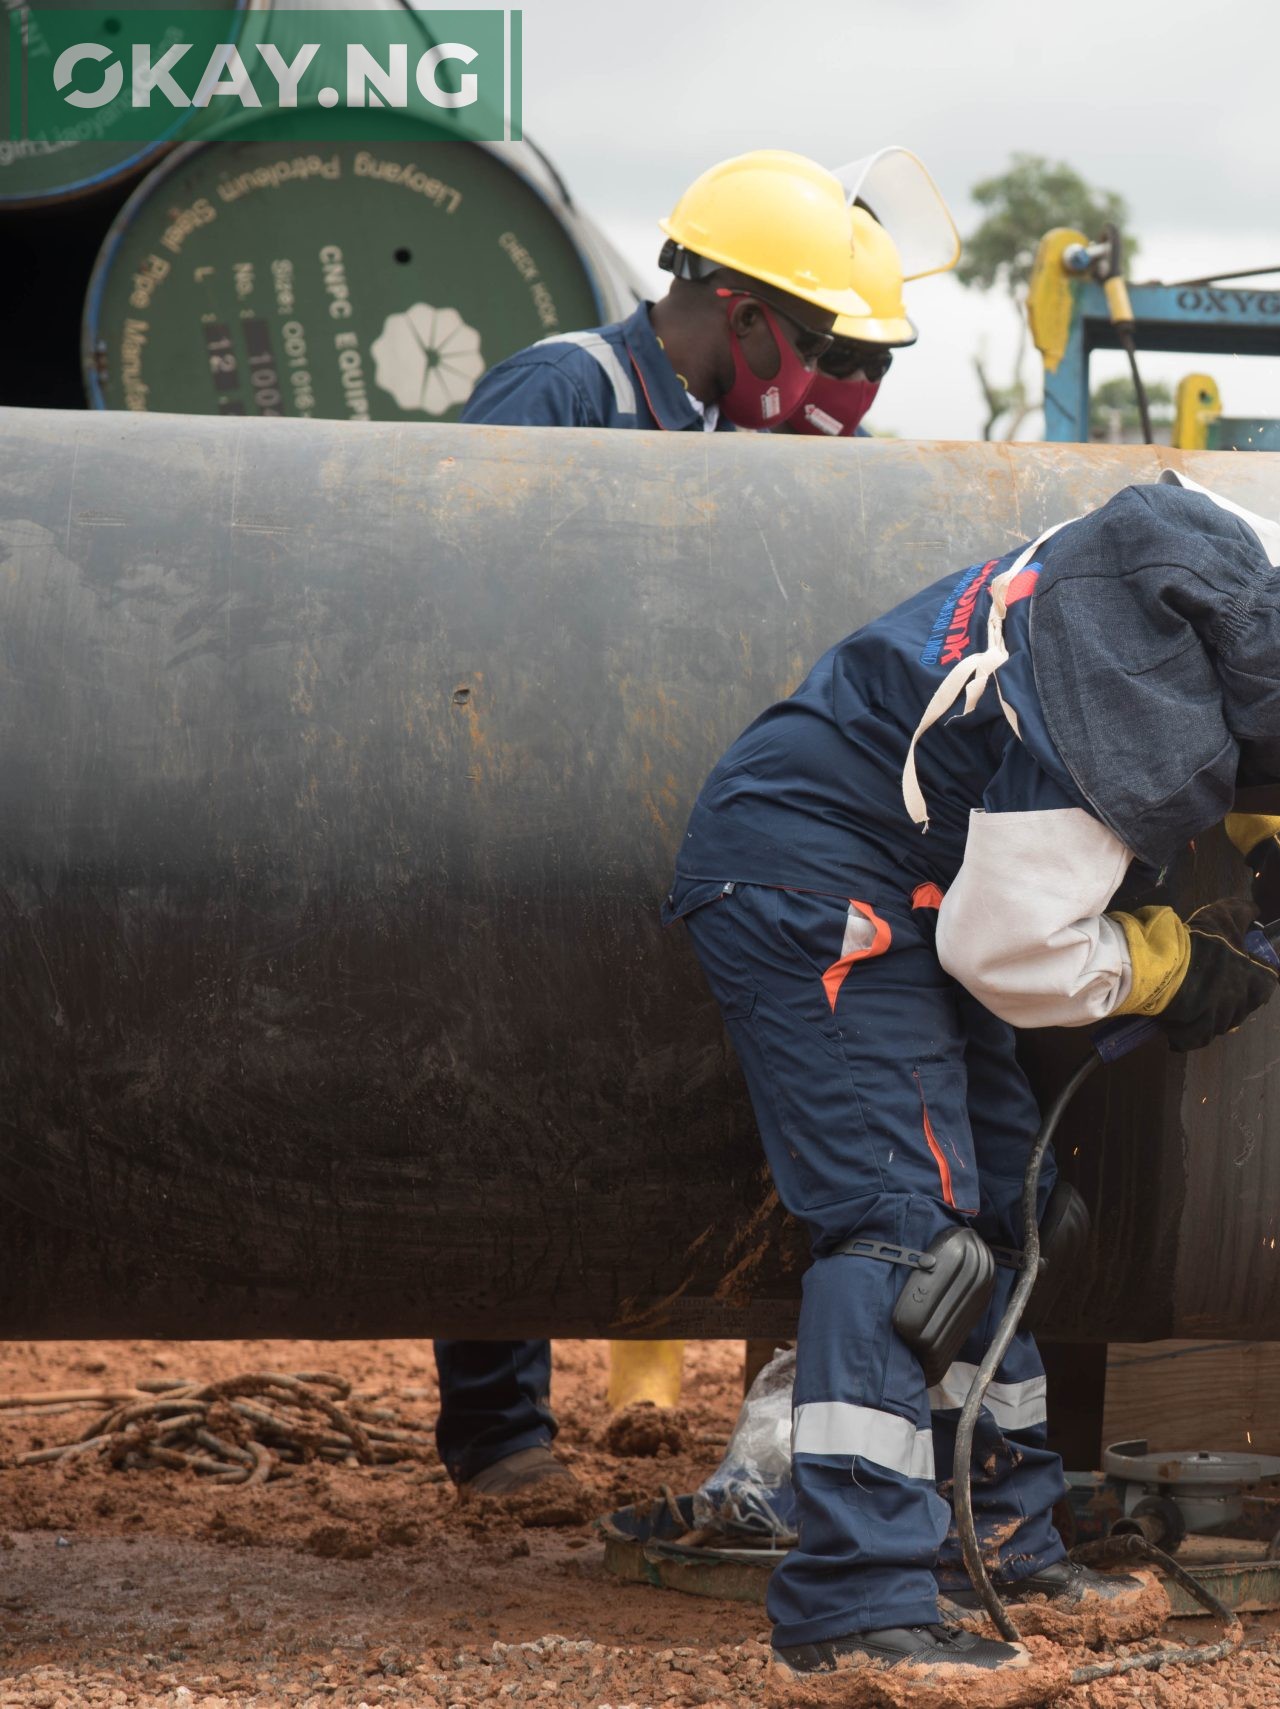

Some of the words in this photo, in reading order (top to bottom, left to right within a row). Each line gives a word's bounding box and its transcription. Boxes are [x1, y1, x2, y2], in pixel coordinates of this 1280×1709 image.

[216, 155, 341, 202] Petroleum
[354, 151, 462, 215] Liaoyang
[160, 198, 217, 254] Steel
[130, 254, 171, 309] Pipe
[319, 245, 353, 319] CNPC
[498, 232, 540, 281] CHECK
[529, 281, 559, 328] HOOK
